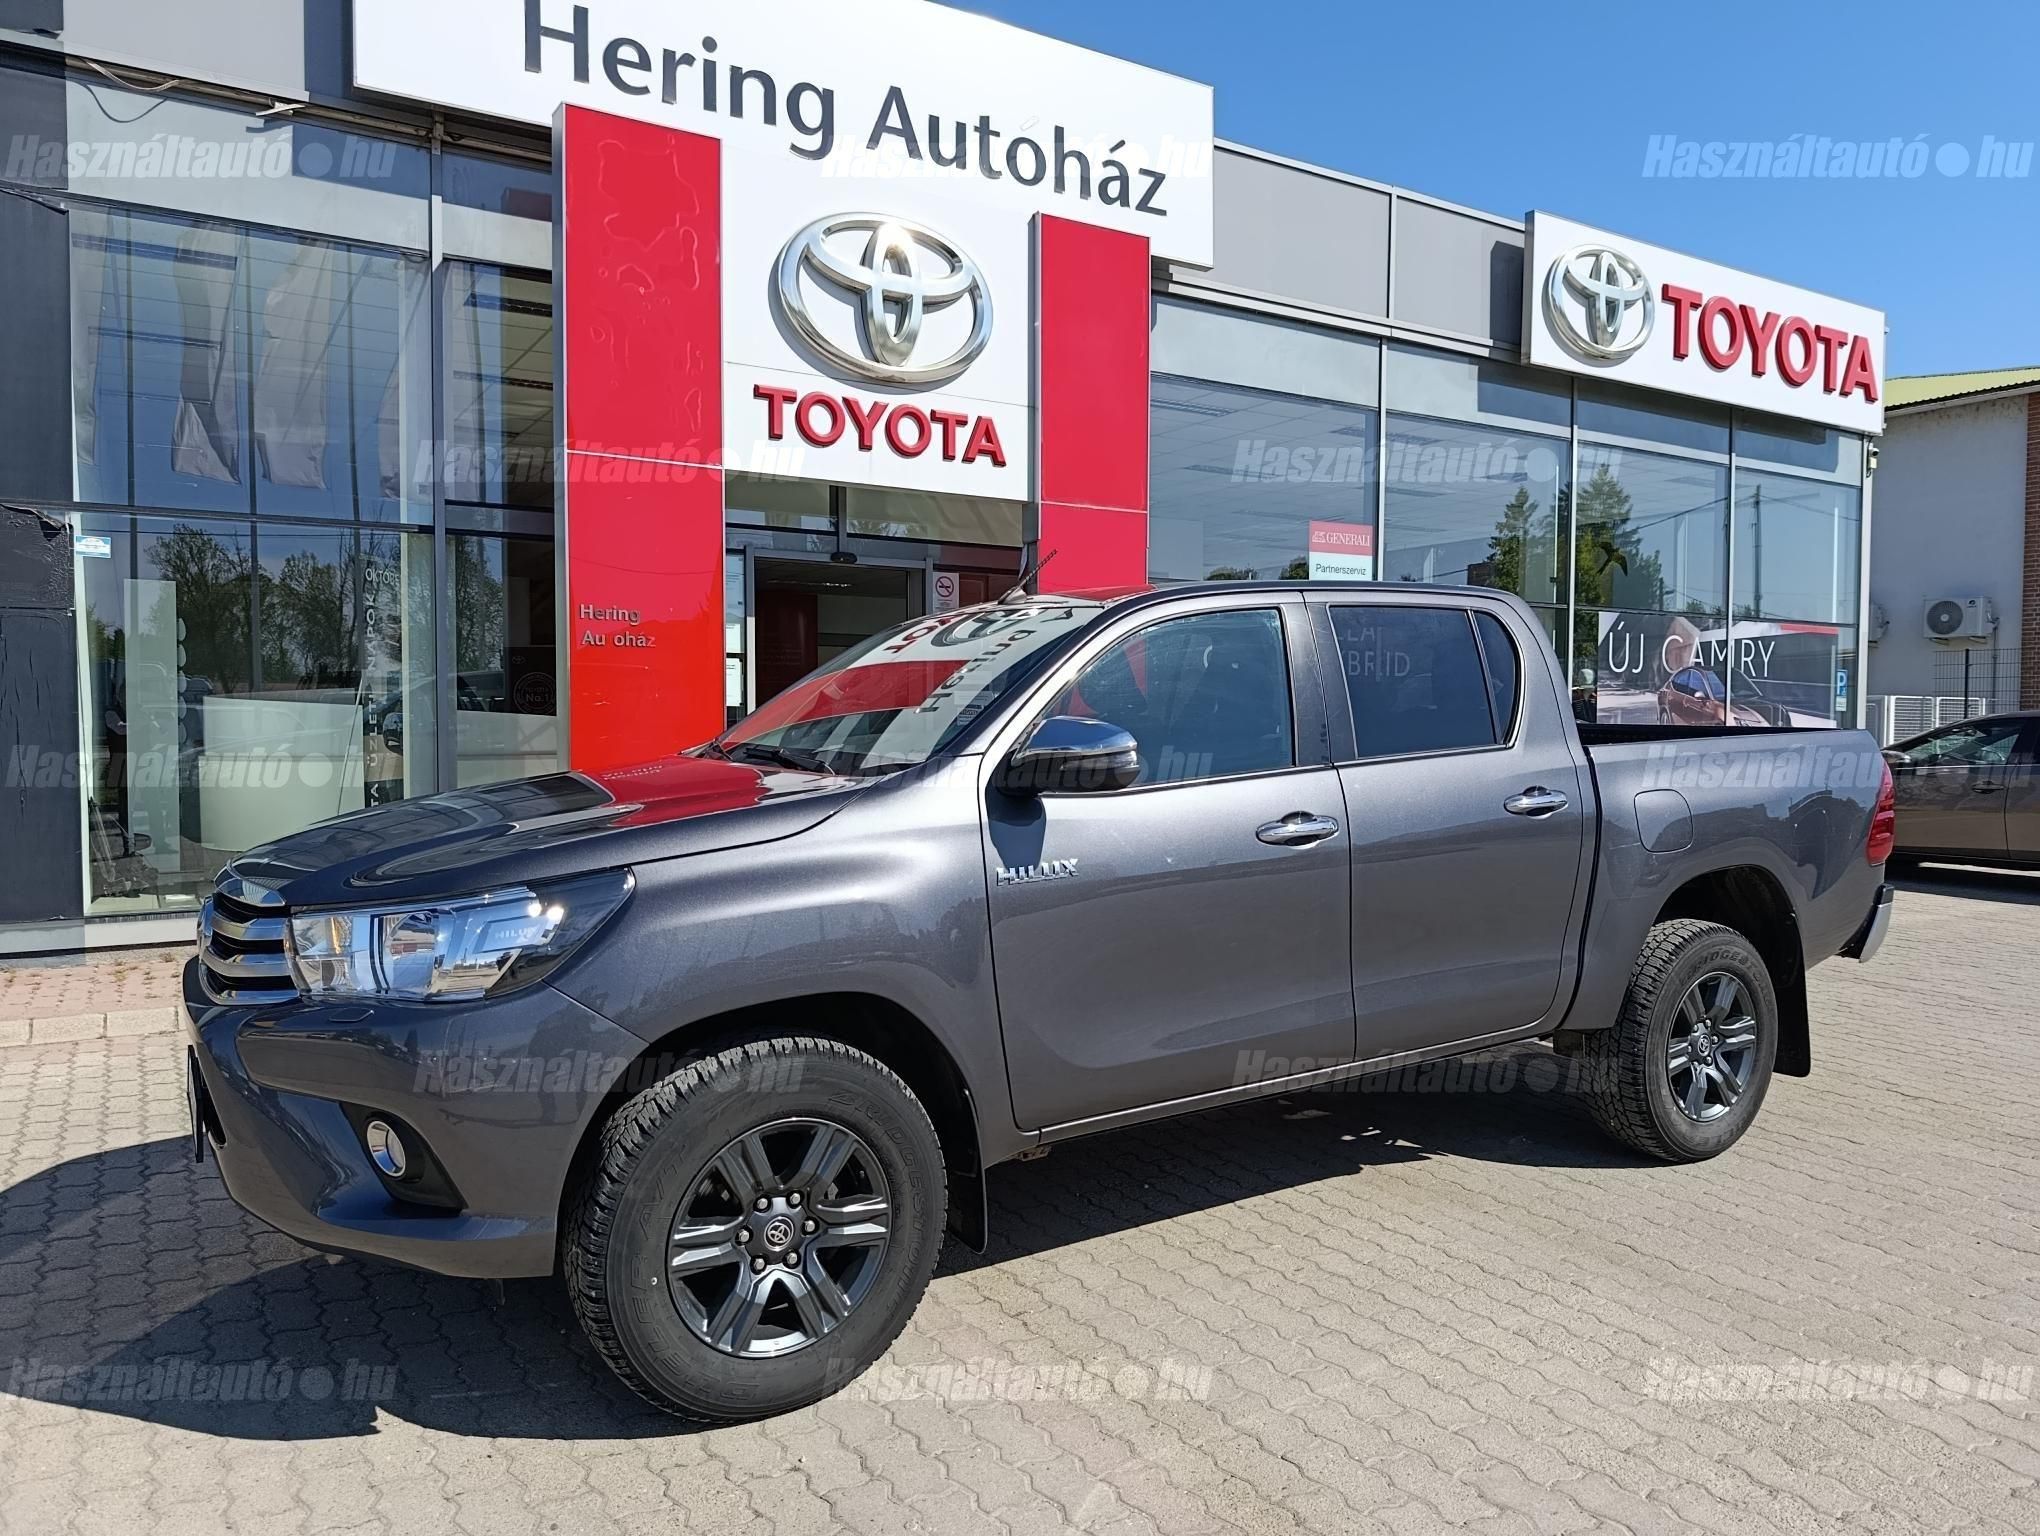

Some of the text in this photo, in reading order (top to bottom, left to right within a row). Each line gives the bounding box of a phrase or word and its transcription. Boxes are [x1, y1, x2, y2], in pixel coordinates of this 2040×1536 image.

[524, 0, 834, 161] Hering
[1661, 283, 1878, 404] TOYOTA
[753, 384, 1006, 468] TOYOTA
[1326, 532, 1371, 547] GENERALI
[1315, 563, 1367, 576] Partnerszerviz
[579, 603, 641, 626] Hering
[1607, 621, 1776, 678] ÚJ CAMRY
[996, 858, 1080, 887] HILUX
